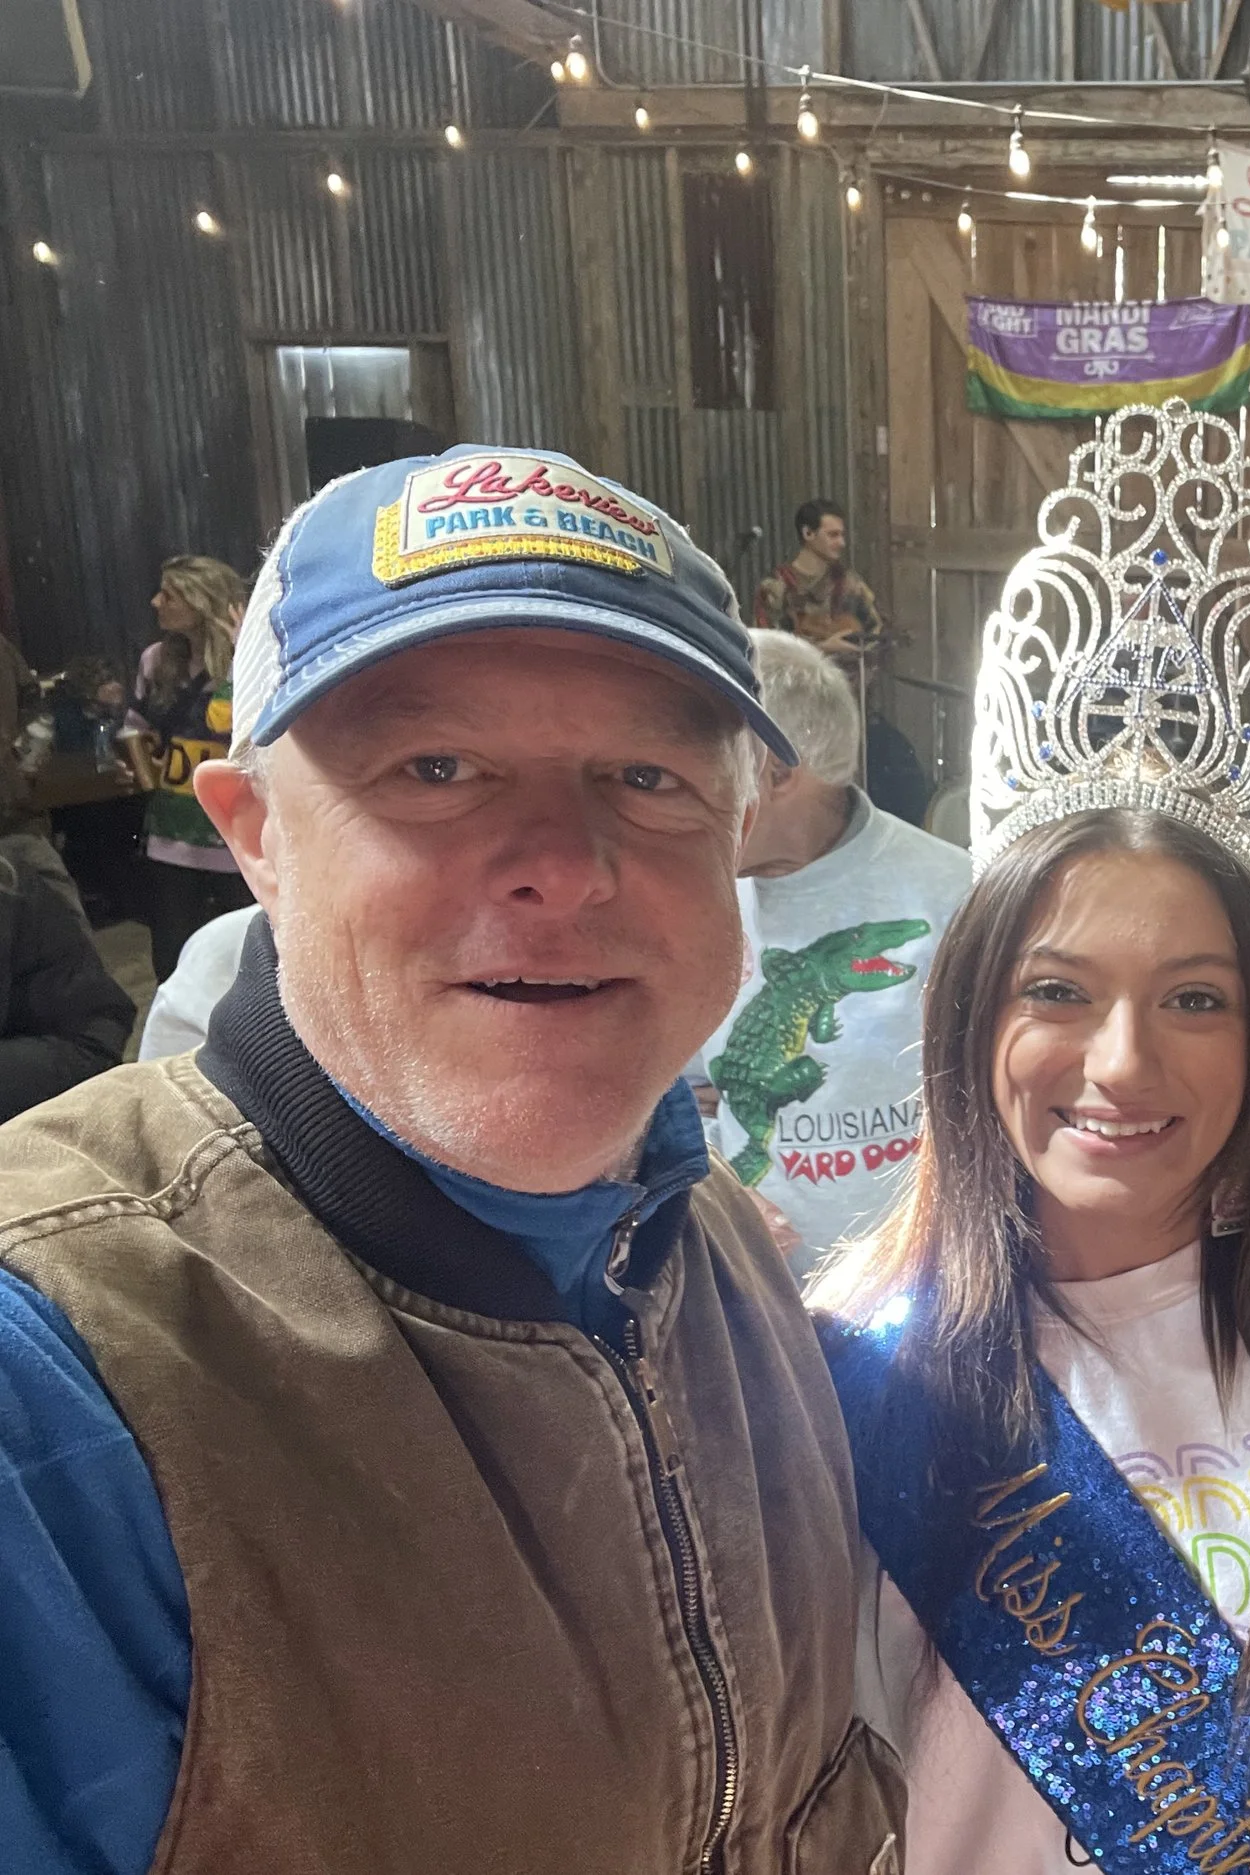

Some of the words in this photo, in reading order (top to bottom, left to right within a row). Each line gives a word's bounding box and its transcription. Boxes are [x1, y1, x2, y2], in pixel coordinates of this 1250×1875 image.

[1056, 301, 1150, 326] MARDI
[1056, 327, 1149, 353] GRAS
[417, 461, 659, 536] Lakeview
[425, 505, 516, 539] PARK
[523, 508, 548, 527] &
[556, 509, 658, 563] BEACH
[779, 1149, 856, 1186] YARD
[972, 1462, 1084, 1657] Miss
